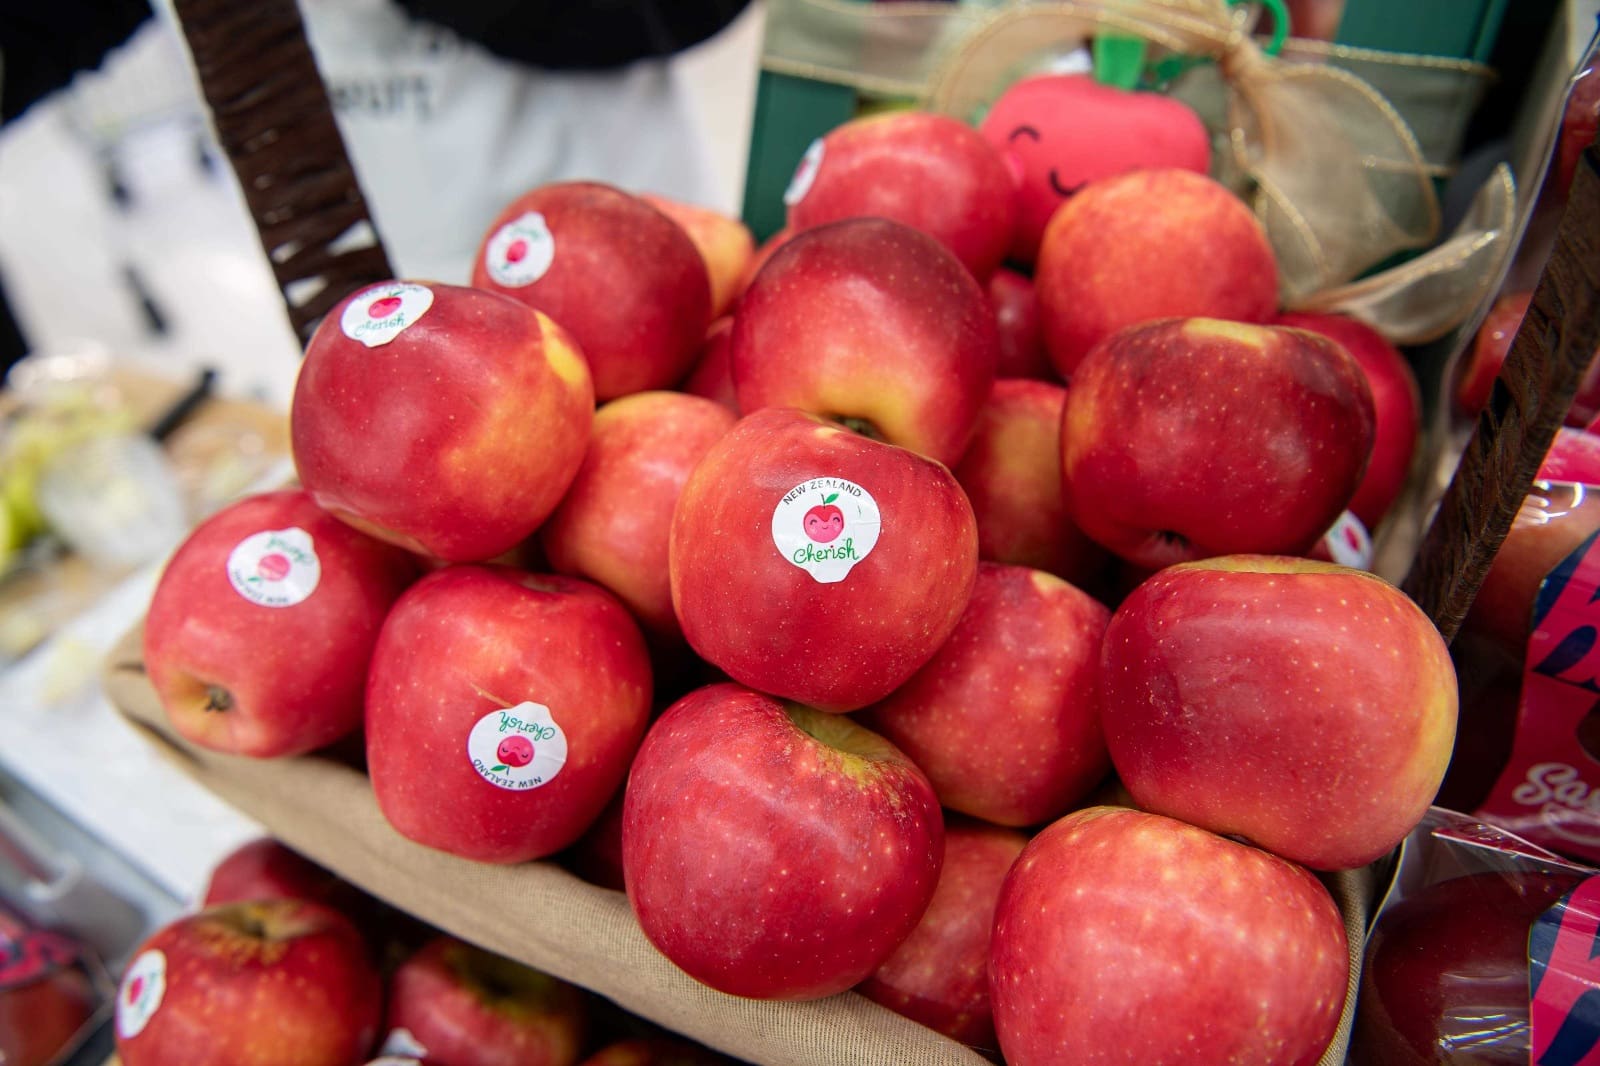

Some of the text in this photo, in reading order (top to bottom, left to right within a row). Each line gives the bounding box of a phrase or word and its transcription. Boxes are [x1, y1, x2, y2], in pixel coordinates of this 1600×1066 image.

[783, 478, 862, 505] NEW ZEALAND
[793, 537, 859, 564] Cherish
[500, 711, 555, 741] Cherish
[473, 758, 542, 788] NEW ZEALAND
